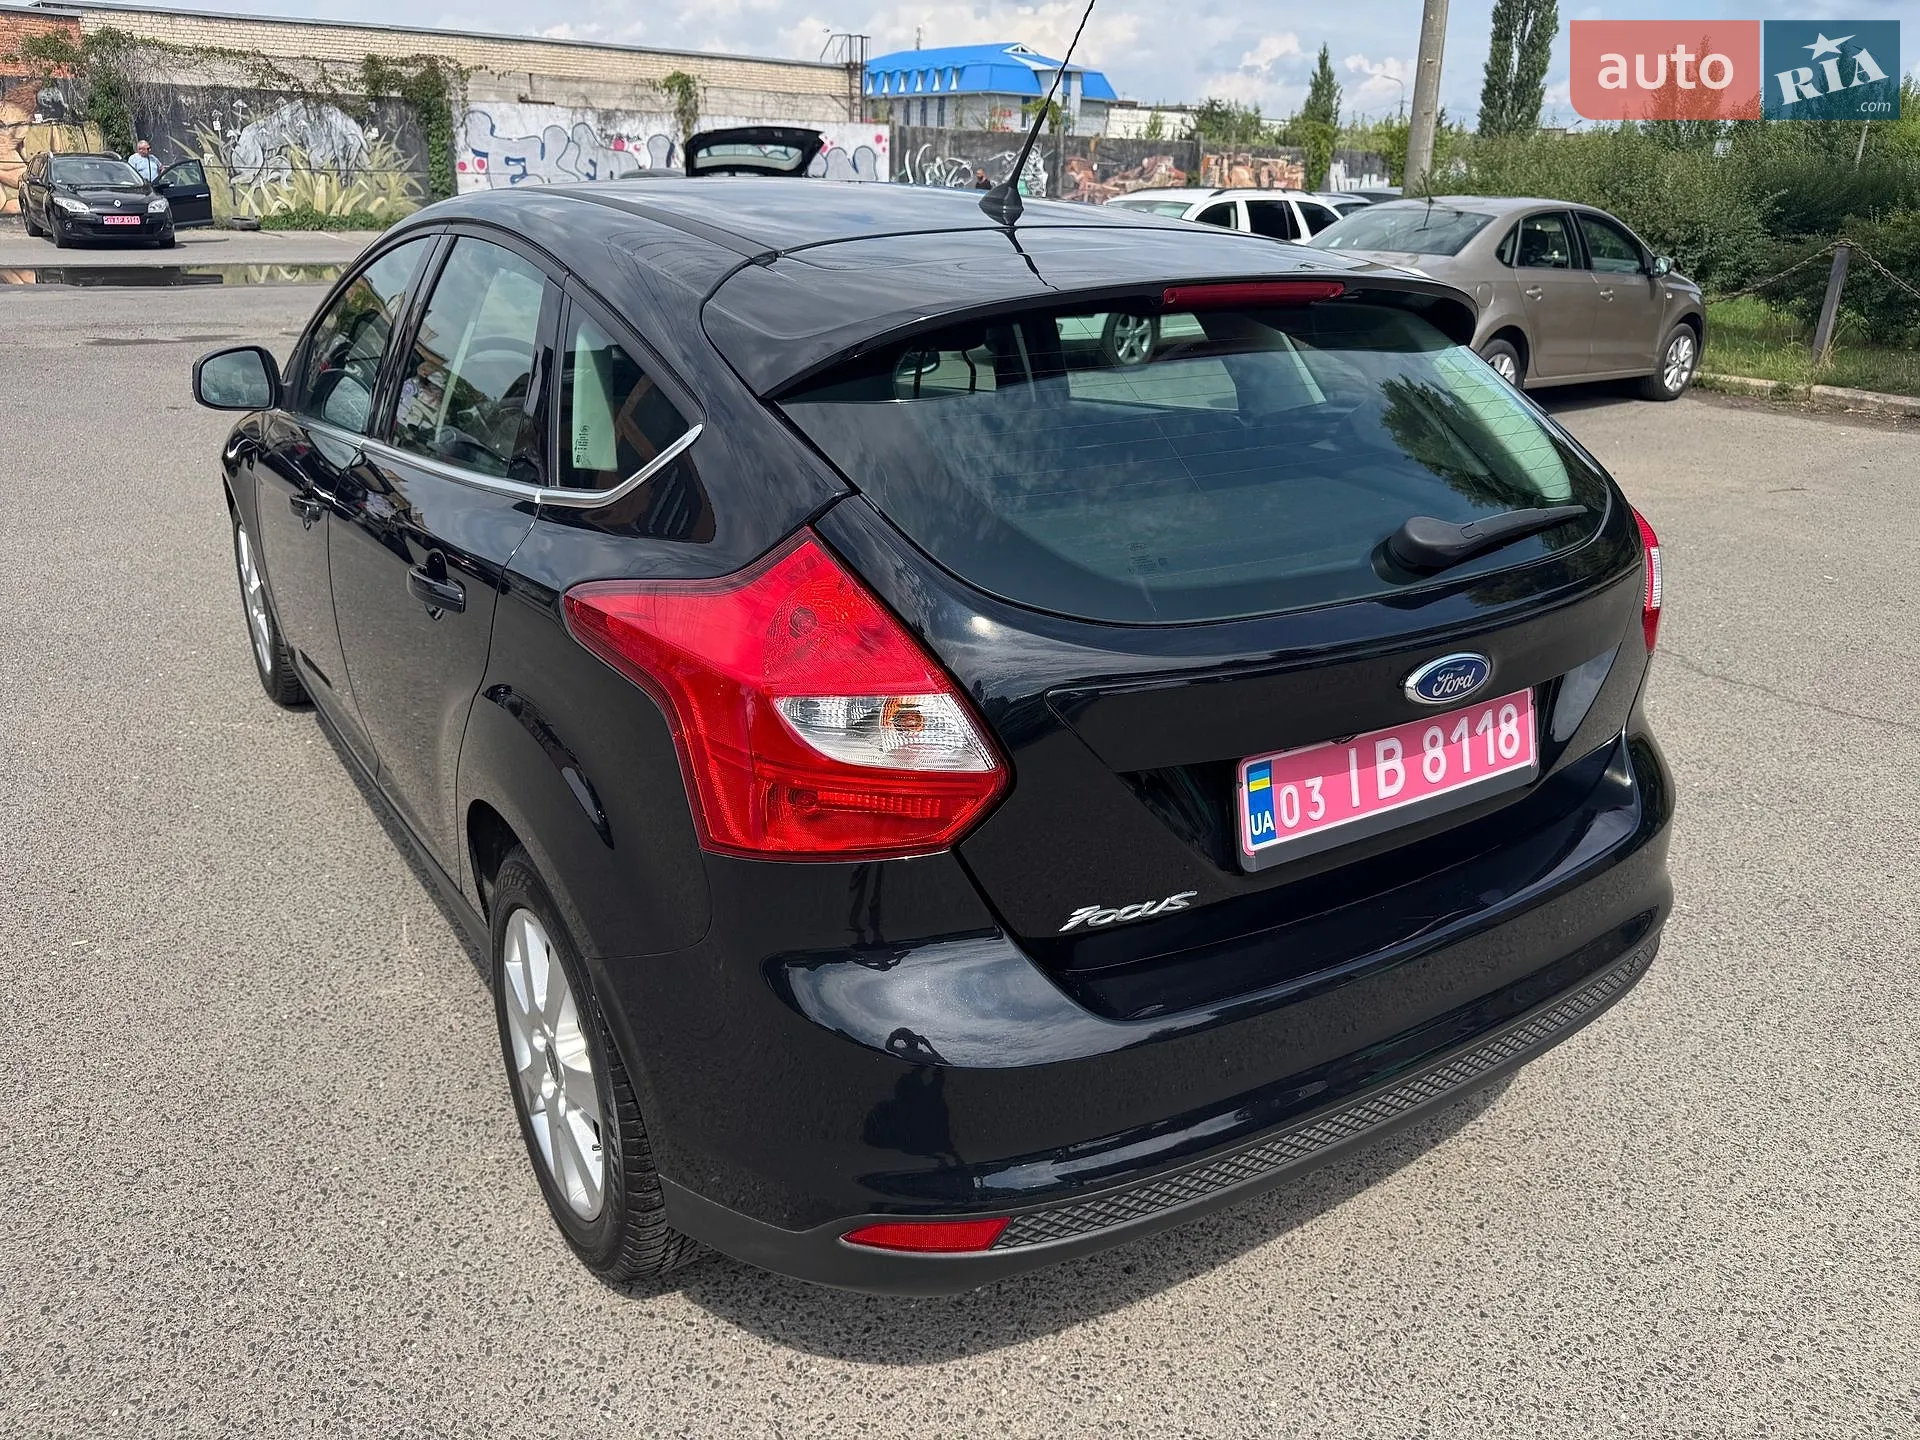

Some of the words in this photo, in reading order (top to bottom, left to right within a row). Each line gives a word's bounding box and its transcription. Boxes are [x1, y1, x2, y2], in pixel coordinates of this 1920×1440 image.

[1432, 664, 1476, 697] Ford
[1279, 776, 1326, 828] 03
[1348, 737, 1406, 808] IB
[1422, 703, 1521, 784] 8118
[1250, 810, 1275, 836] UA
